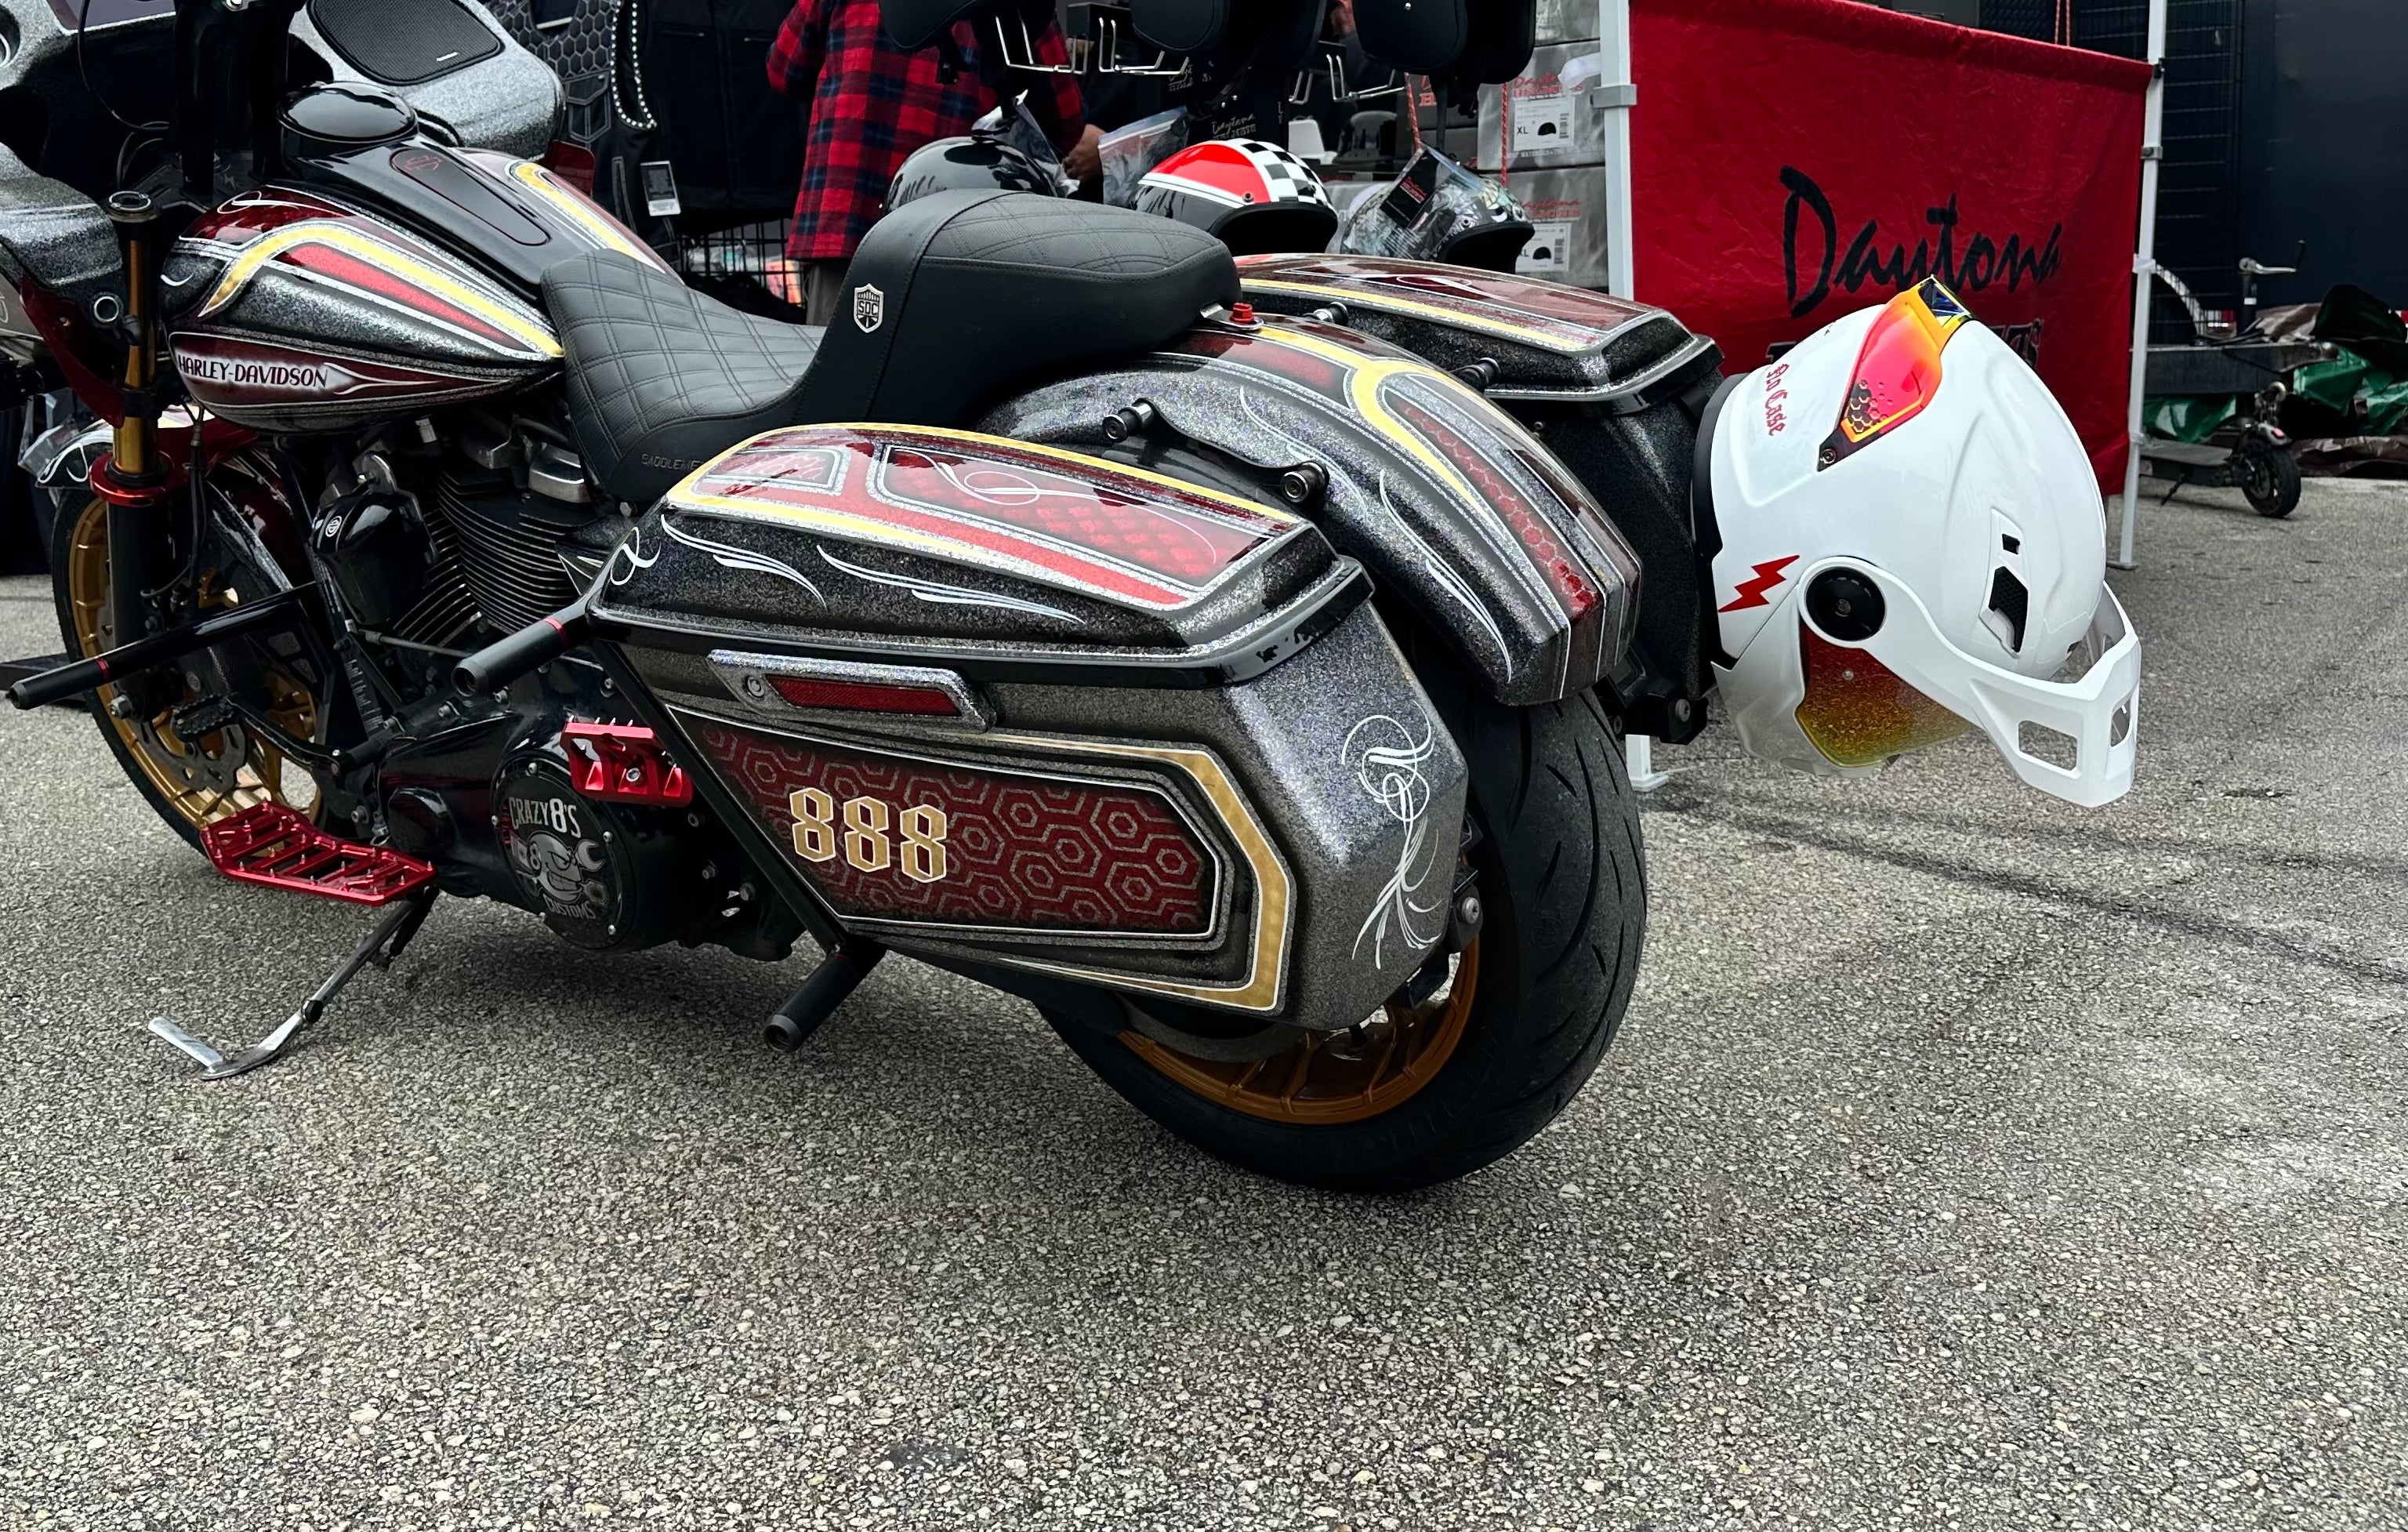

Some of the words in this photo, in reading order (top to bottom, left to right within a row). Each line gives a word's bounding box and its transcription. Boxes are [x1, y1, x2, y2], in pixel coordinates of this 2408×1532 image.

[1517, 126, 1529, 135] XL
[1779, 165, 2062, 318] Daytona
[858, 300, 879, 315] SDC
[177, 354, 328, 388] HARLEY-DAVIDSON
[1764, 390, 1788, 436] Case
[641, 453, 704, 471] SADDLEME
[789, 786, 947, 883] 888
[542, 893, 597, 920] CUSTOMS
